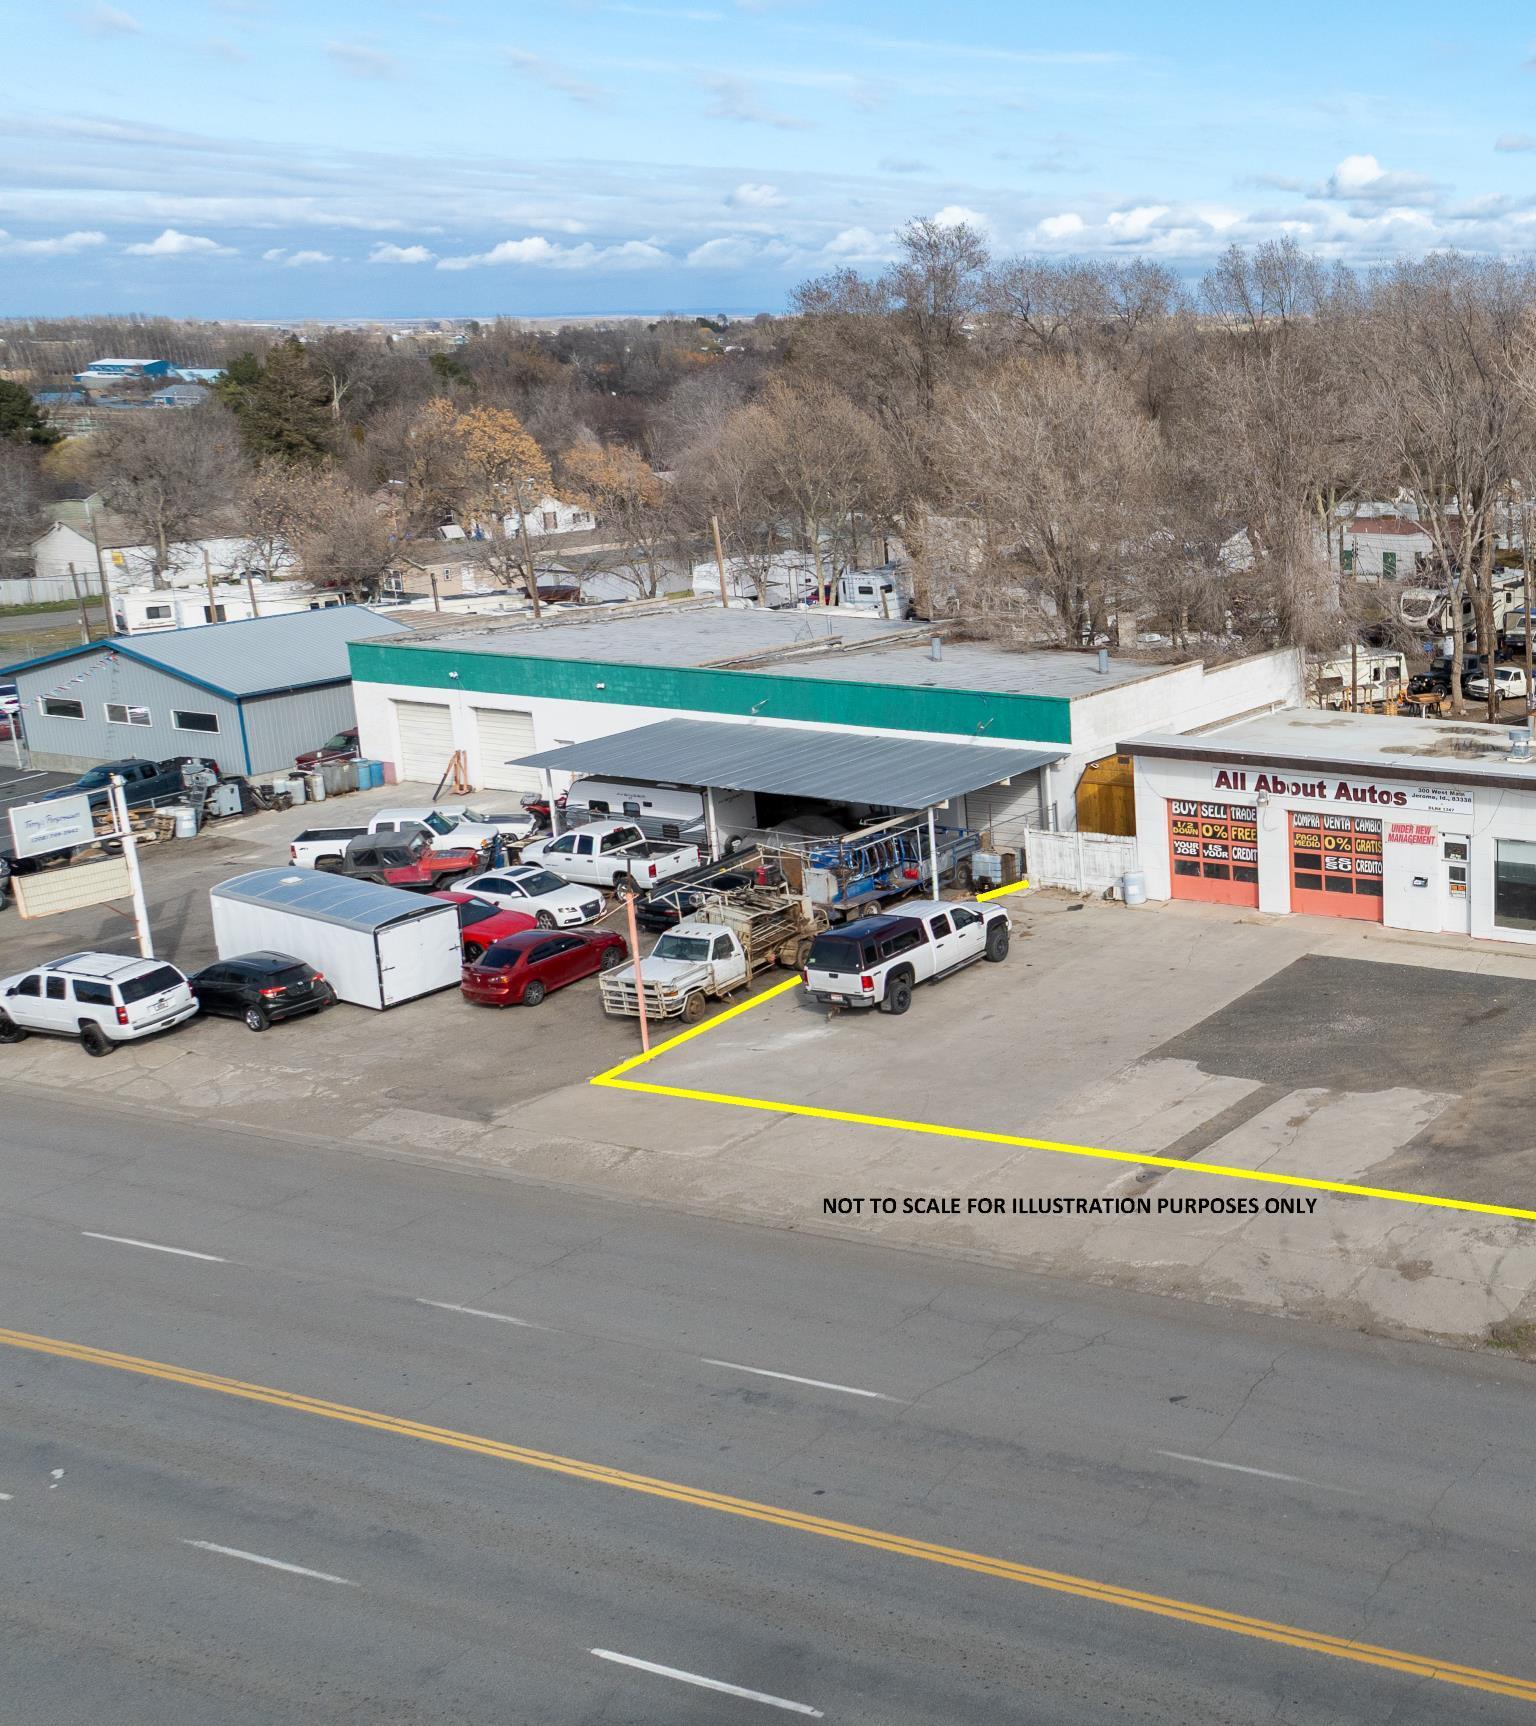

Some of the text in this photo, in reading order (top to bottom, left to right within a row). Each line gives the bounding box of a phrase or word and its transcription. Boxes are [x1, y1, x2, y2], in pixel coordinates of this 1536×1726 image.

[1215, 770, 1408, 806] All About Autos
[1431, 788, 1448, 796] West
[1411, 792, 1438, 801] Jerome,
[1171, 801, 1257, 821] BUY SELL TRADE
[1176, 821, 1194, 829] 1/2
[1293, 813, 1382, 833] COMPRA VENTA CAMBIO
[1172, 826, 1198, 836] DOWN
[1202, 824, 1257, 841] 0% FREE
[1391, 823, 1432, 835] UNDER NEW
[1295, 833, 1319, 842] PAGO
[1387, 833, 1436, 845] MANAGEMENT
[1173, 840, 1199, 850] YOUR
[1294, 839, 1321, 848] MEDIO
[1324, 836, 1382, 854] 0% GRATIS
[1176, 847, 1198, 855] JOB
[1203, 849, 1228, 858] YOUR
[1232, 846, 1257, 862] CREDIT
[1355, 859, 1383, 874] CREDITO
